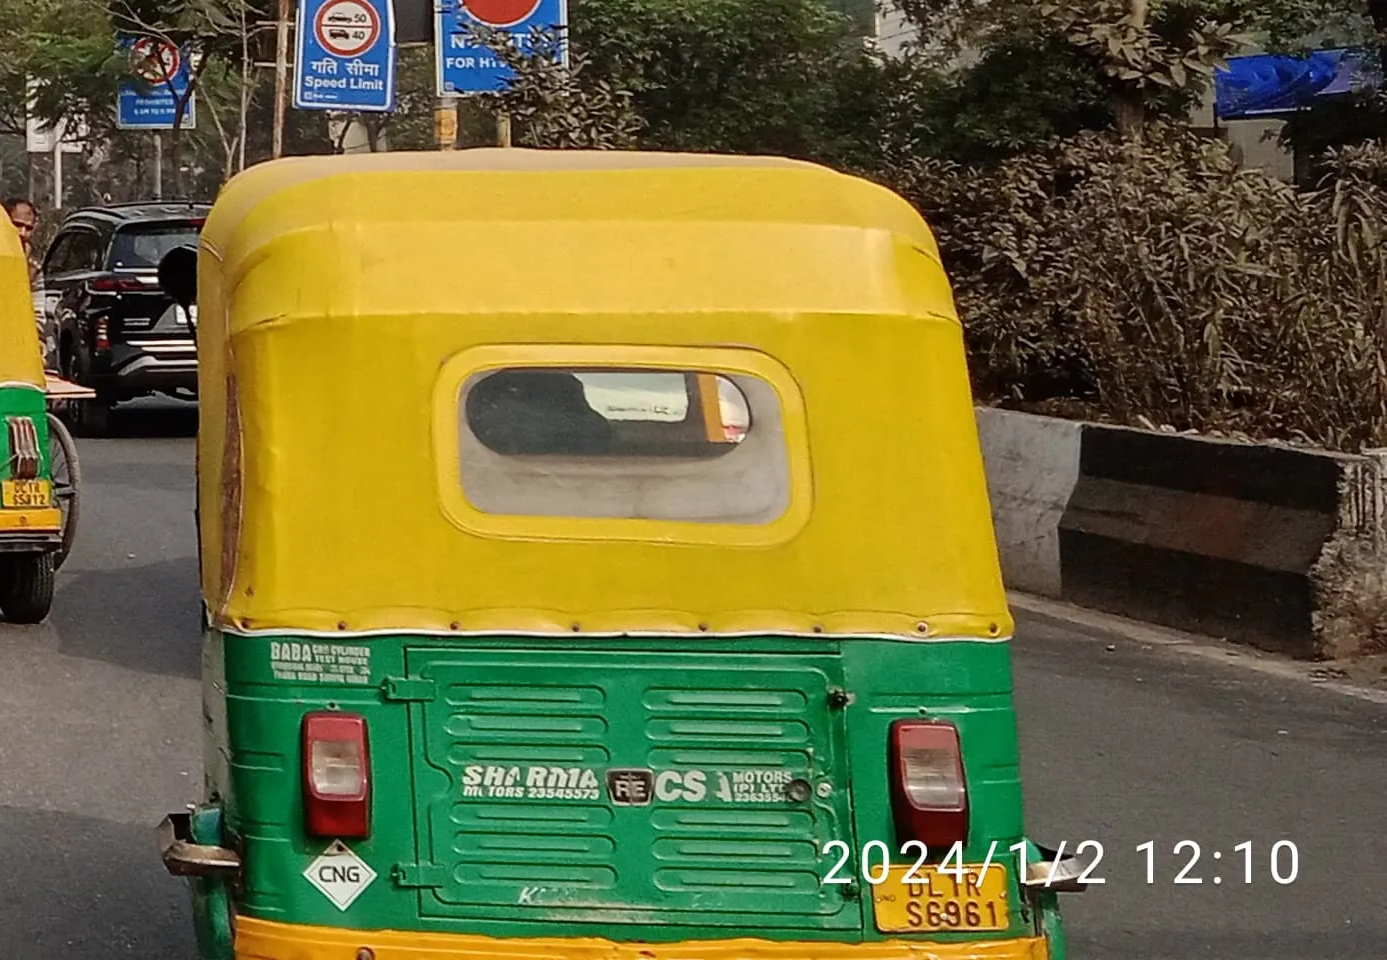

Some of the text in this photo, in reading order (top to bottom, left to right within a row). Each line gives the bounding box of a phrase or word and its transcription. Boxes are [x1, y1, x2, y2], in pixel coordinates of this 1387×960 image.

[354, 13, 367, 24] 50
[352, 30, 365, 40] 40
[450, 33, 480, 49] N
[310, 56, 380, 77] गति सीमा
[446, 56, 475, 69] FOR
[304, 75, 384, 91] Speed Limit
[271, 641, 312, 662] BABA
[733, 771, 793, 785] MOTORS
[319, 865, 361, 883] CNG
[907, 900, 998, 928] S6961
